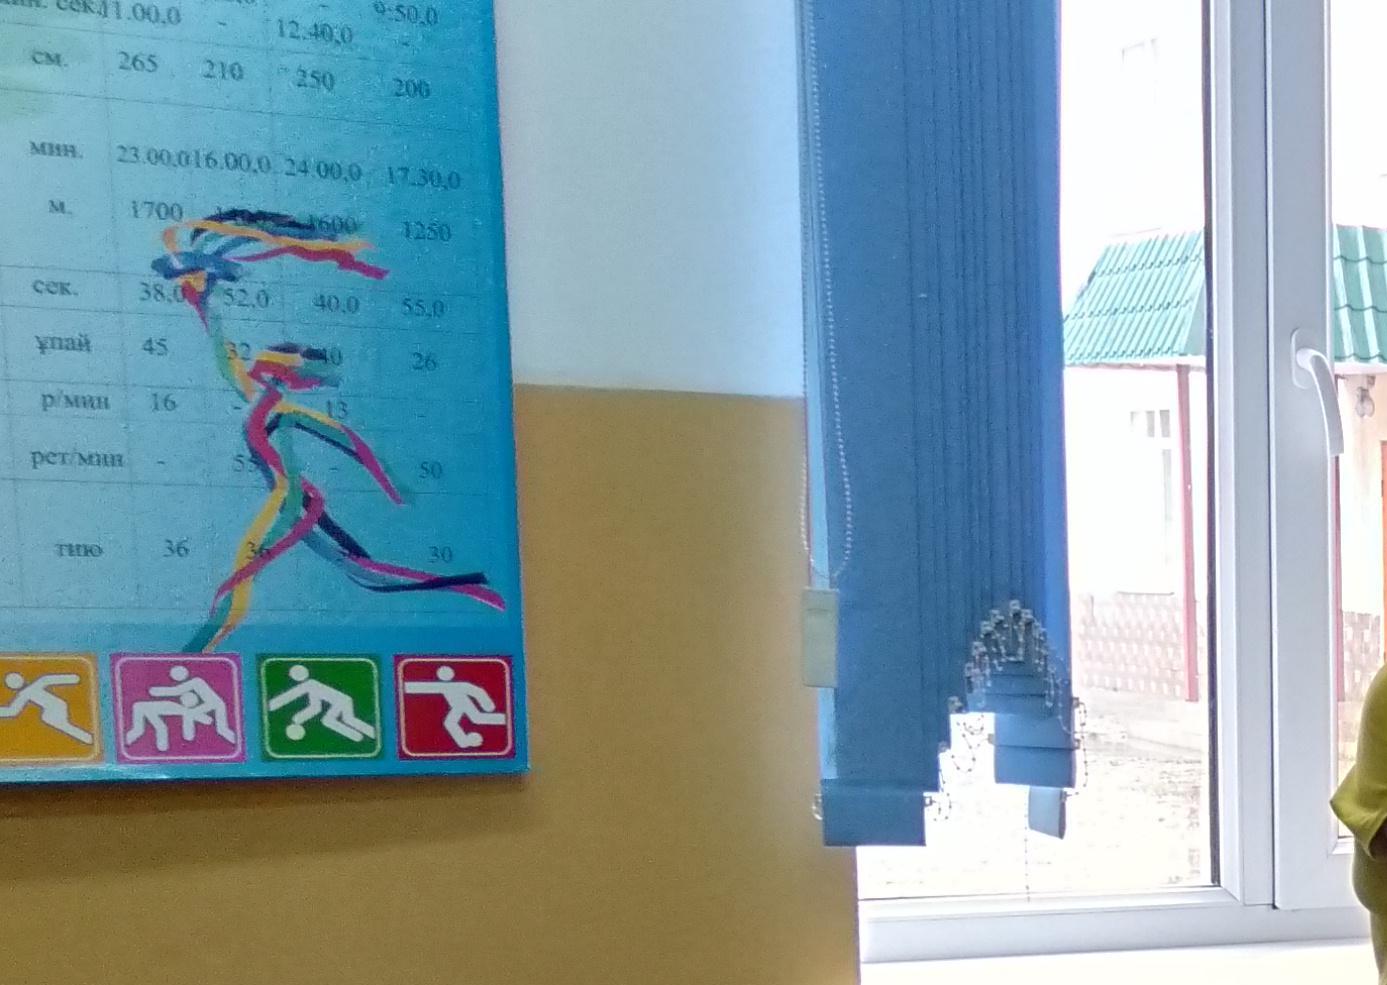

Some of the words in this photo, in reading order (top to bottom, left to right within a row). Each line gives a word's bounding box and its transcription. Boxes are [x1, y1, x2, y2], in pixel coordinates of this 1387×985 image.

[31, 51, 68, 67] см.
[118, 50, 159, 73] 265
[203, 59, 244, 82] 210
[296, 67, 336, 92] 250
[392, 77, 431, 99] 200
[29, 141, 83, 159] мин.
[48, 200, 72, 214] м.
[131, 201, 184, 222] 1700
[32, 280, 78, 296] сек.
[142, 337, 169, 356] 45
[151, 393, 178, 412] 16
[419, 461, 444, 480] 50
[163, 539, 190, 558] 36
